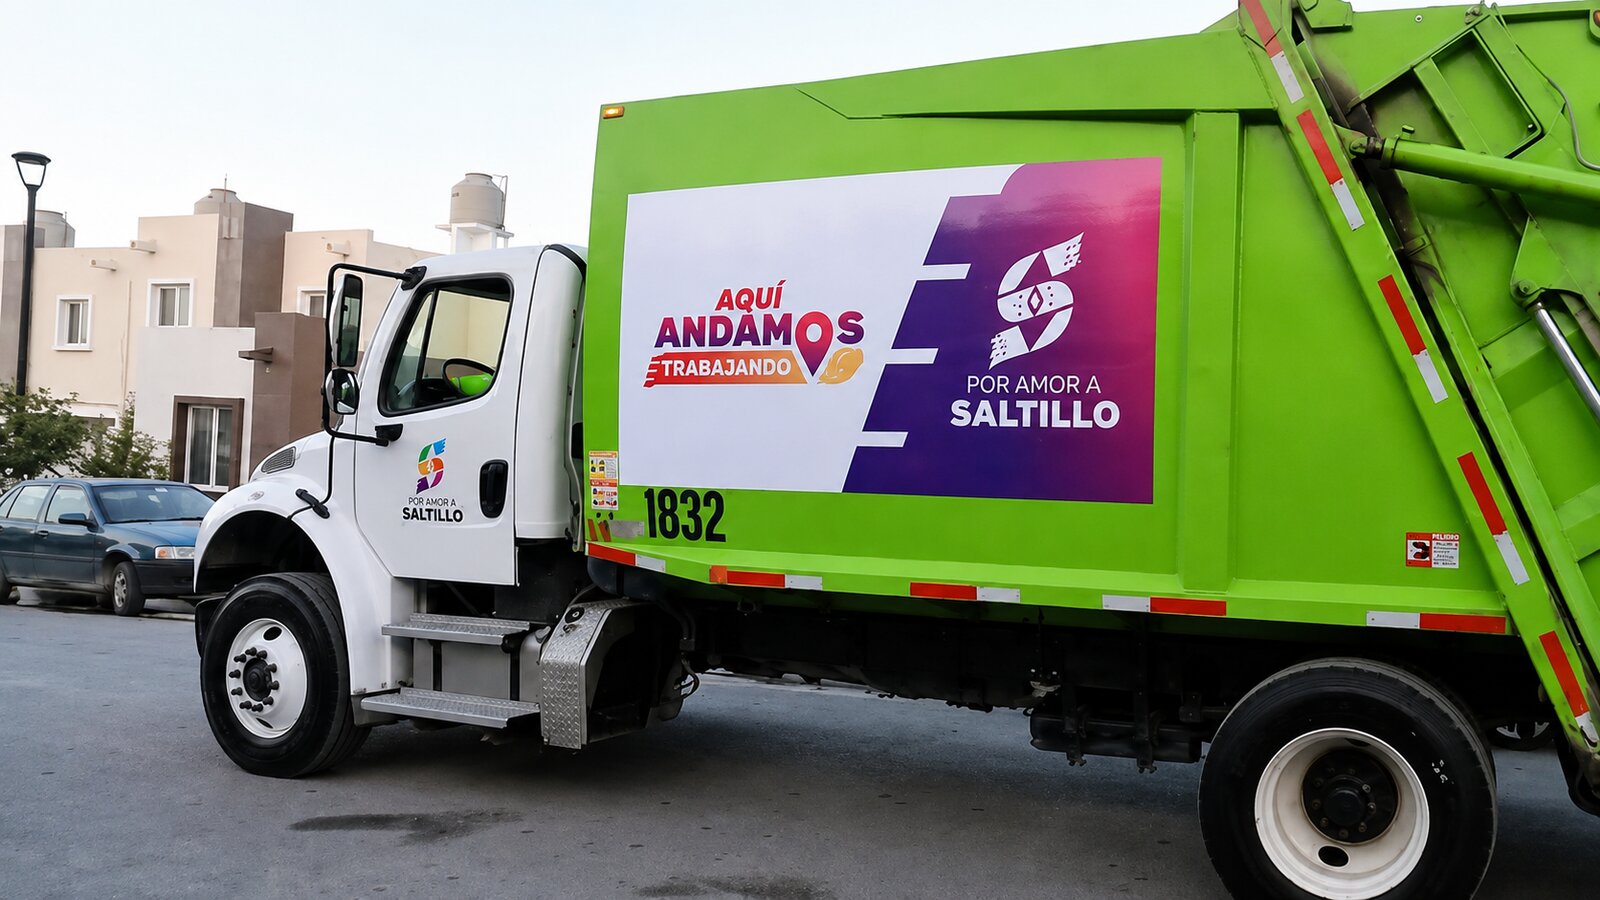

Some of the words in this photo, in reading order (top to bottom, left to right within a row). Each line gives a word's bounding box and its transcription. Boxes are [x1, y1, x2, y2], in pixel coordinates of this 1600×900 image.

[715, 280, 786, 313] AQUÍ
[654, 311, 864, 376] ANDAMOS
[661, 358, 792, 377] TRABAJANDO
[967, 375, 1010, 394] POR
[1015, 375, 1080, 394] AMOR
[1085, 375, 1101, 394] A
[950, 399, 1121, 429] SALTILLO
[408, 497, 424, 506] POR
[426, 498, 449, 507] AMOR
[450, 499, 456, 507] A
[402, 507, 464, 523] SALTILLO
[644, 488, 726, 542] 1832
